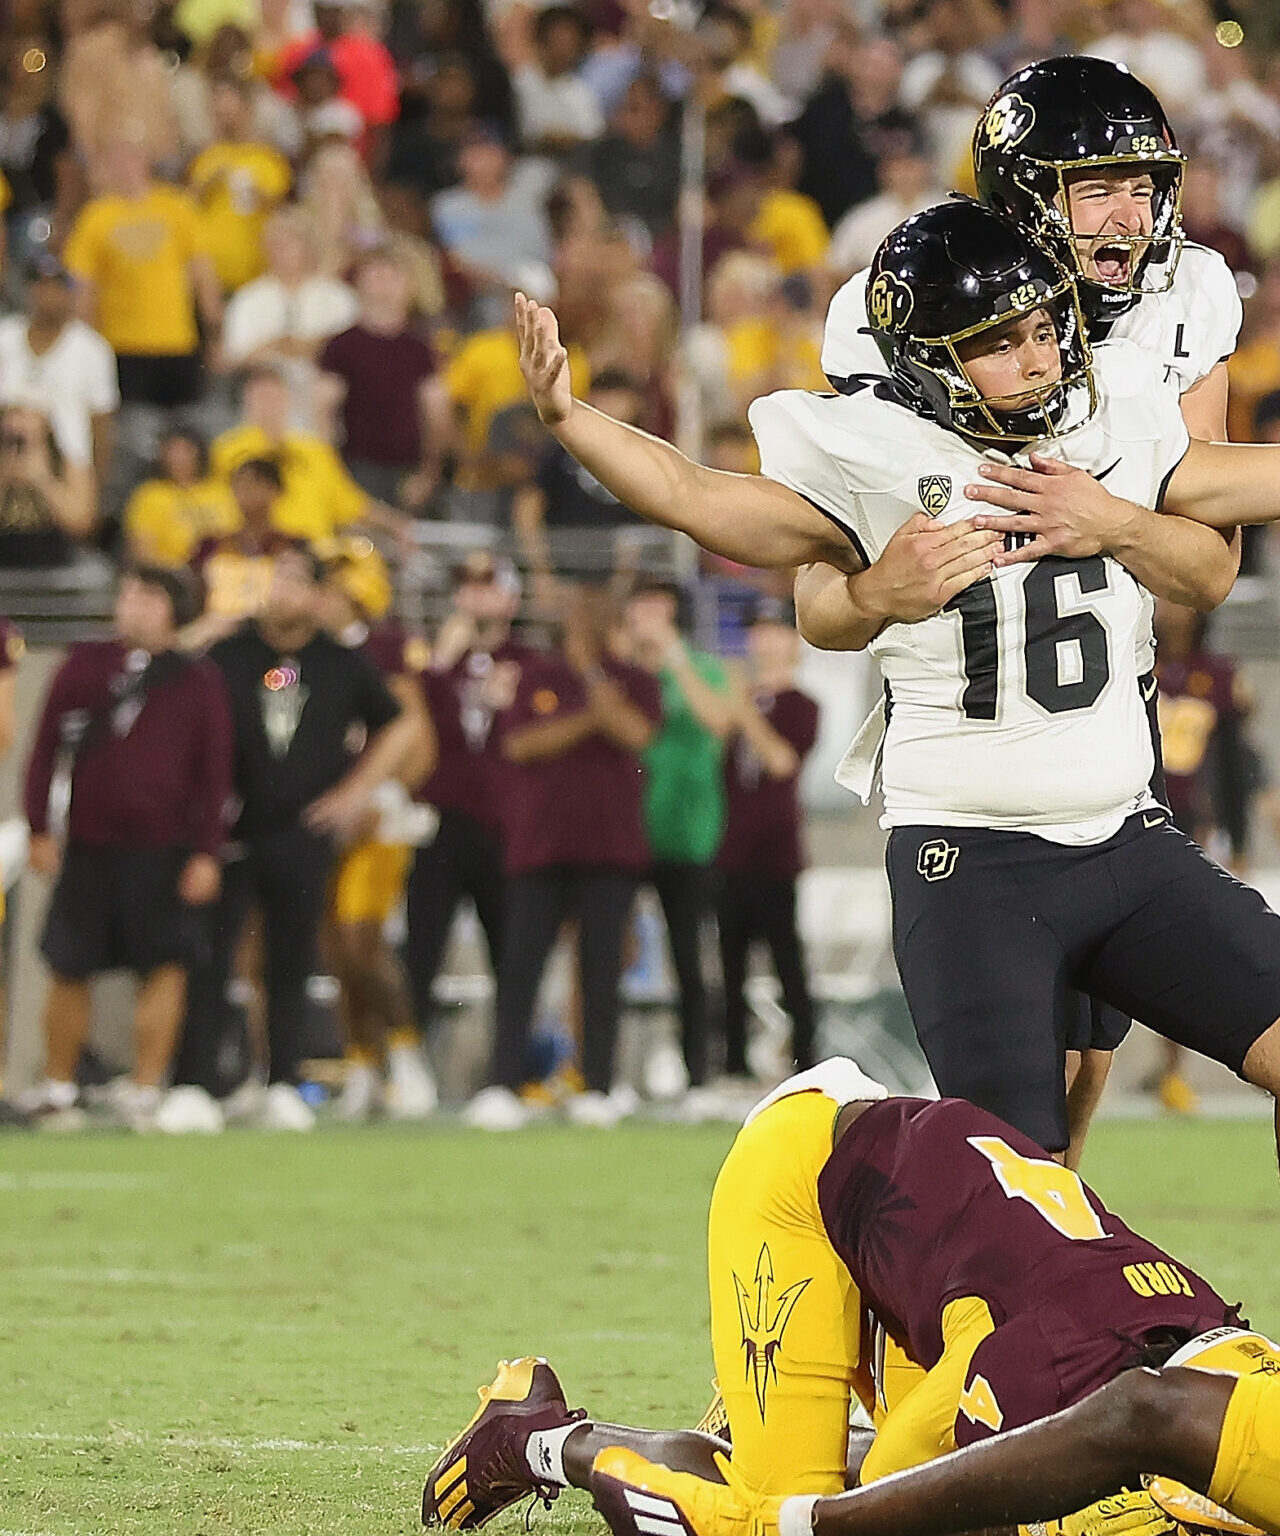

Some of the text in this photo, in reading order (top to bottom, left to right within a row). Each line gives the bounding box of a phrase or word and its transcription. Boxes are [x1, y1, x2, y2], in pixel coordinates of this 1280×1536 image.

[927, 493, 943, 508] 12
[941, 554, 1115, 724] 16
[965, 1136, 1114, 1241] 4
[1122, 1261, 1196, 1298] FORD
[958, 1373, 1004, 1432] 4
